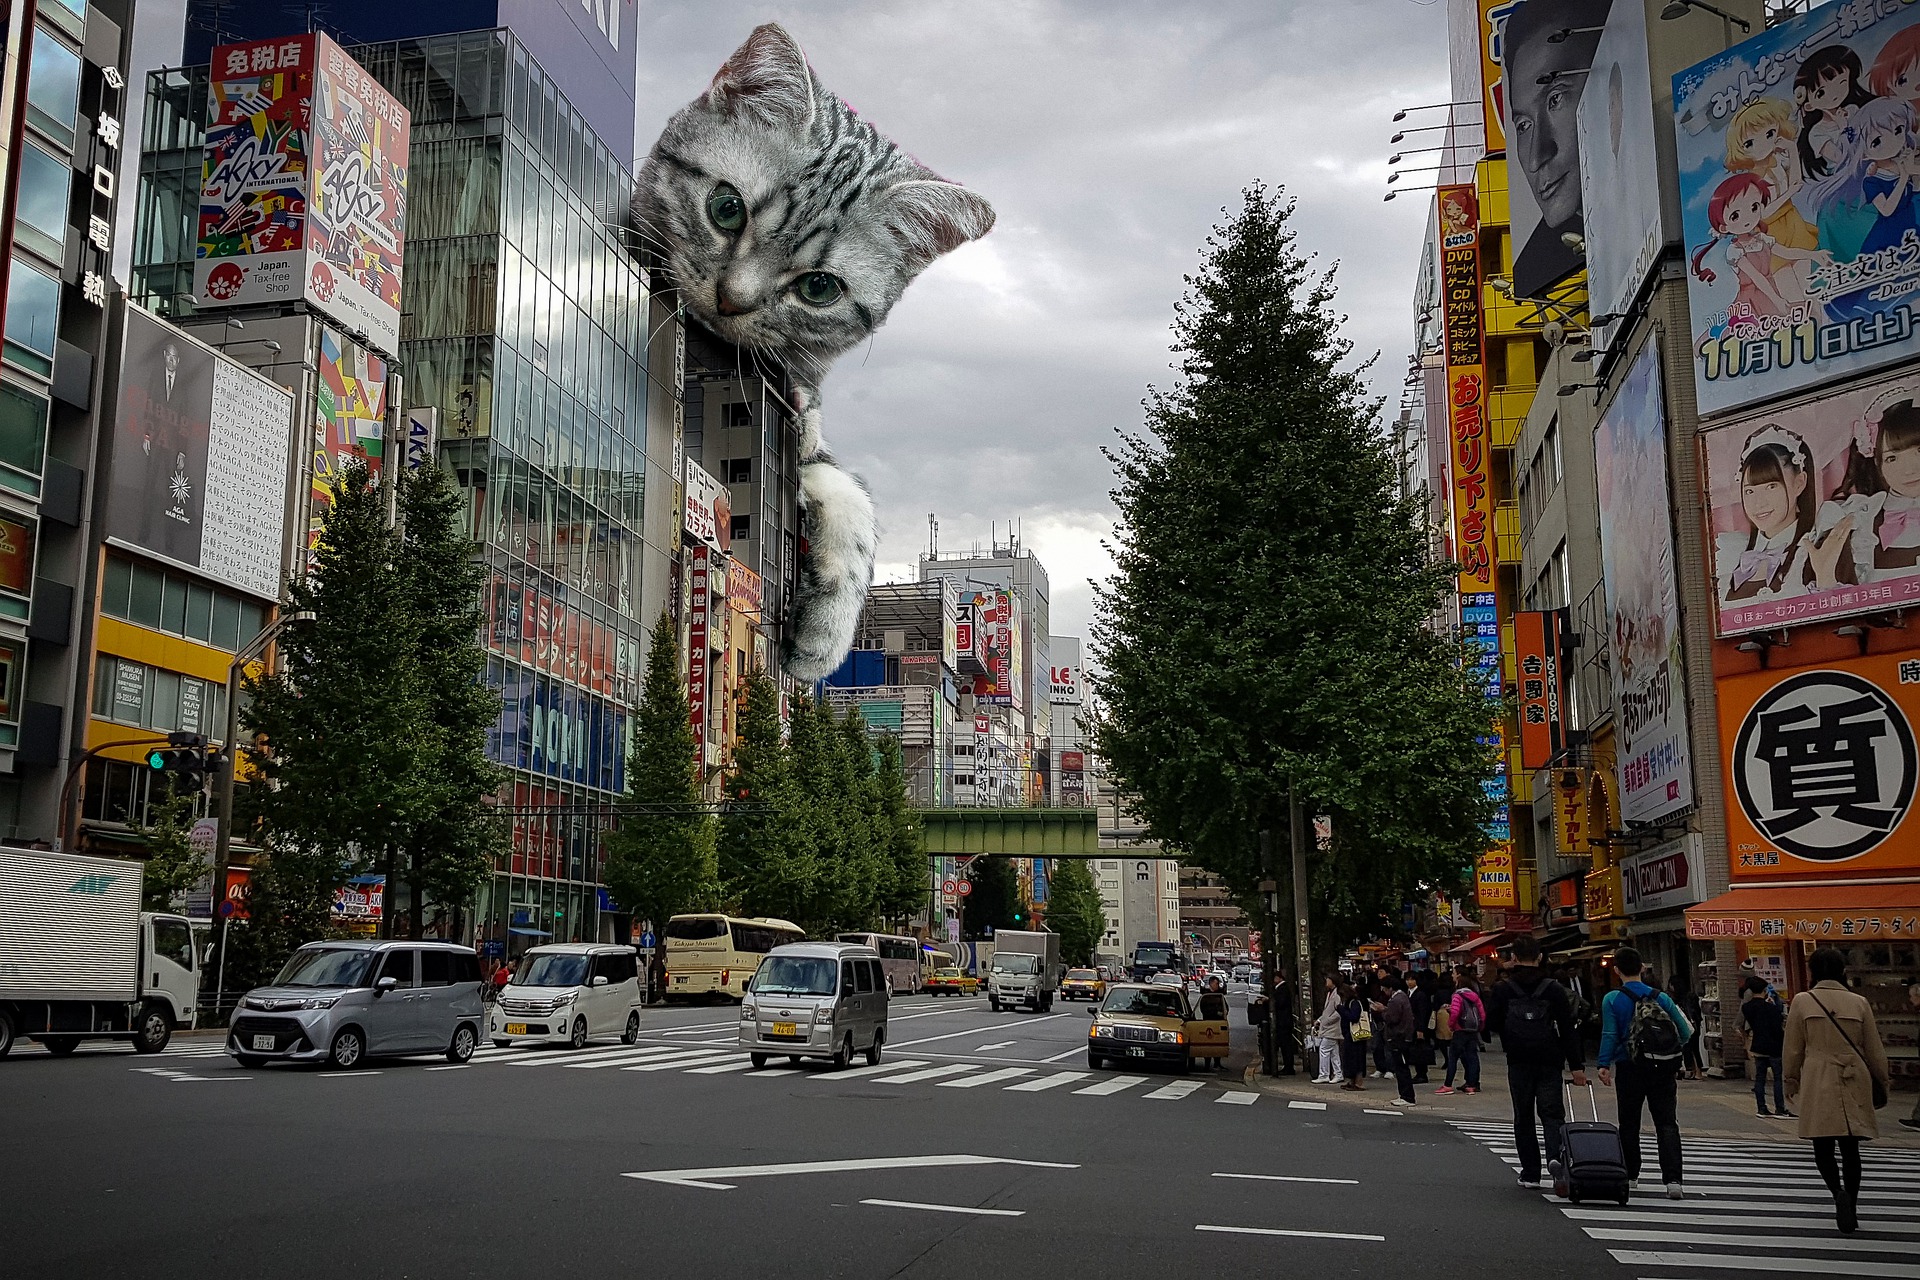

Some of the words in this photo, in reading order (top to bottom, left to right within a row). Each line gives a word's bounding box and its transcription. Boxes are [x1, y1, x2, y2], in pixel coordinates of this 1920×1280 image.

[226, 41, 302, 75] 免税店
[213, 148, 283, 194] AKKY
[246, 176, 299, 188] INTERNATIONAL
[325, 166, 381, 221] AKKY
[83, 111, 119, 308] 坂口電熱
[353, 209, 395, 247] INTERNATIONAL
[1445, 234, 1475, 246] あなたの
[1446, 250, 1473, 262] DVD
[257, 260, 291, 273] Japan.
[1445, 263, 1475, 275] ブルーレイ
[253, 273, 290, 283] Tax-free
[1447, 275, 1475, 288] ゲーム
[265, 282, 290, 294] Shop
[1452, 288, 1471, 300] CD
[337, 291, 358, 314] Japan.
[359, 305, 382, 327] Tax-free
[381, 318, 396, 337] Shop
[1448, 303, 1476, 314] アイドル
[1448, 315, 1477, 327] アニメ
[1450, 326, 1477, 338] コミック
[1452, 340, 1477, 351] ホビー
[1701, 305, 1920, 380] 11月11日(土)
[1451, 353, 1478, 365] フィギュア
[687, 512, 713, 538] カラオケ
[1461, 595, 1475, 605] 6F
[1475, 594, 1495, 605] 中古
[1465, 613, 1494, 622] DVD
[1477, 625, 1496, 635] 中古
[997, 627, 1009, 657] DUTY
[996, 659, 1009, 692] FREE
[1521, 654, 1546, 725] 吉野家
[1754, 692, 1903, 840] 質
[1739, 852, 1780, 867] 大黒屋
[1480, 872, 1511, 883] AKIBA
[1480, 887, 1512, 898] 中央通り店
[1688, 918, 1756, 936] 高価買取
